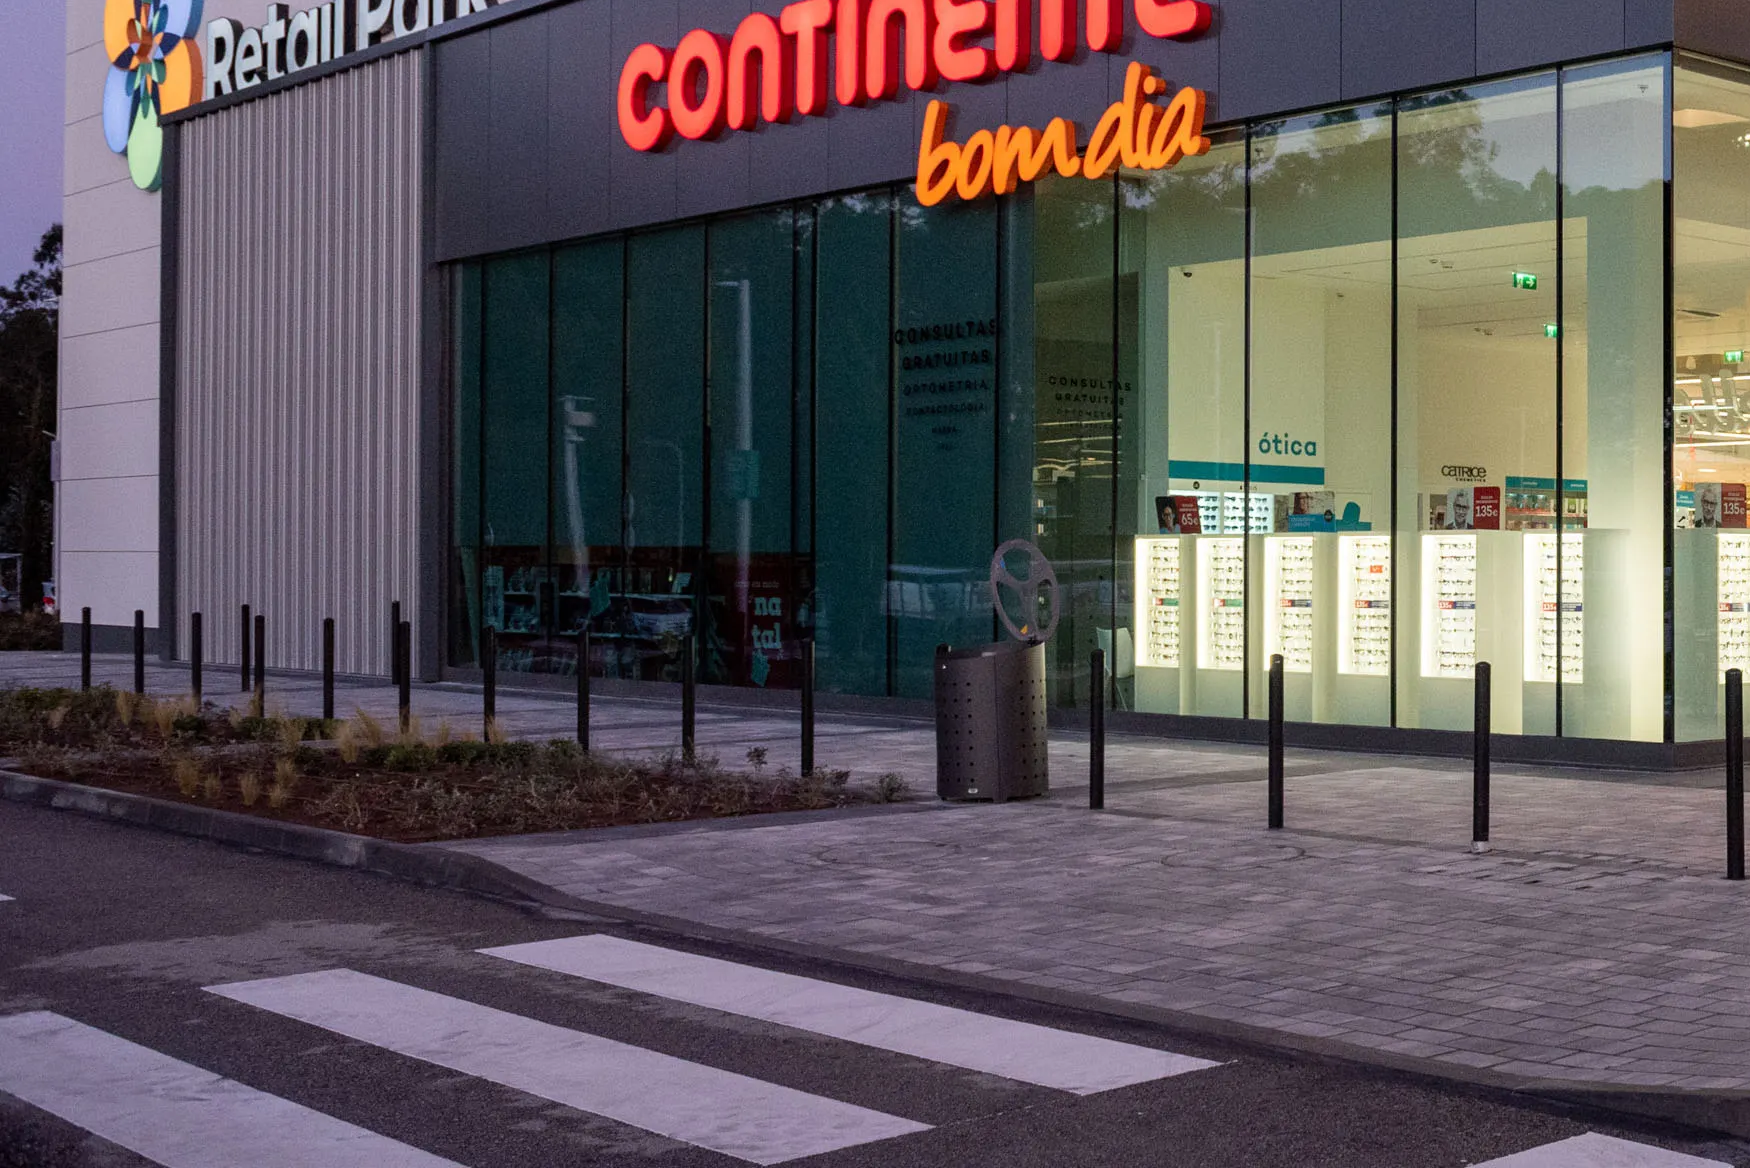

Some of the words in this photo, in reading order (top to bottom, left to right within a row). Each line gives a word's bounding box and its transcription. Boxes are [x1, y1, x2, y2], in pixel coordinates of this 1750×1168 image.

[915, 99, 1083, 207] bom
[1083, 61, 1211, 180] dia
[894, 319, 997, 345] CONSULTAS
[902, 349, 991, 371] GRATUITAS
[1258, 432, 1318, 458] ótica
